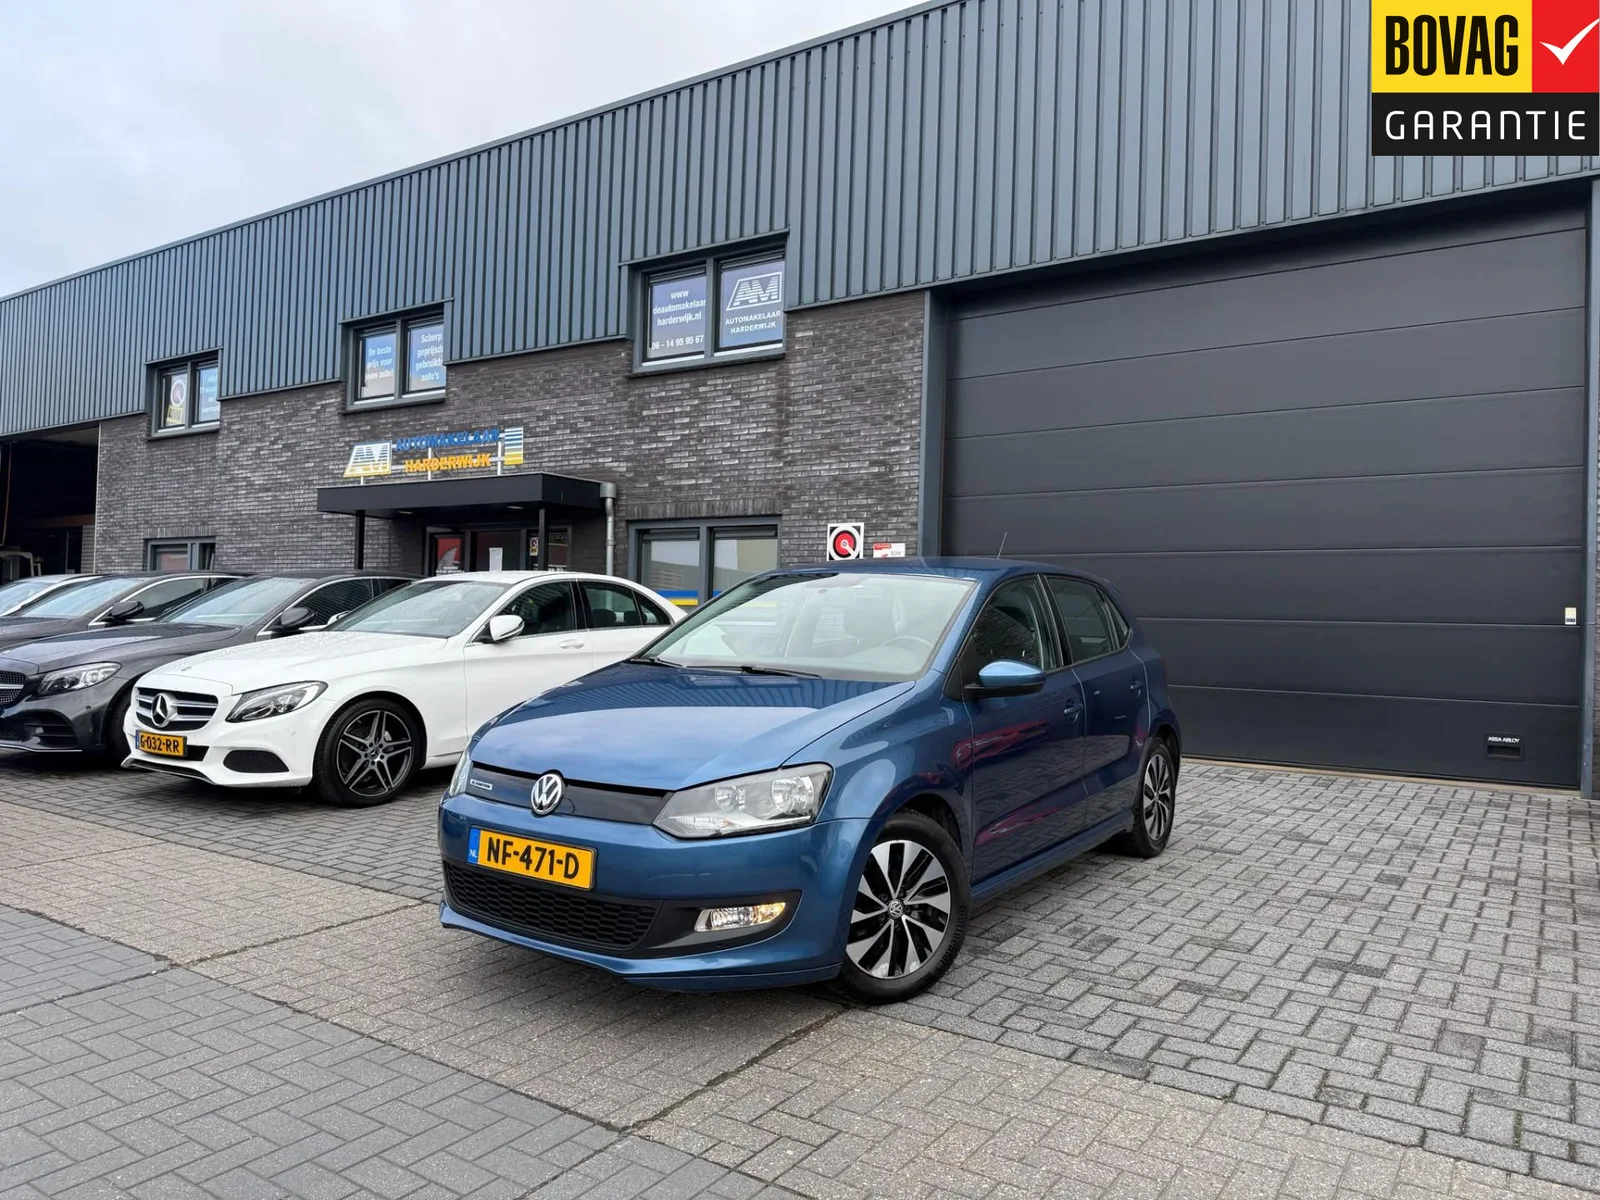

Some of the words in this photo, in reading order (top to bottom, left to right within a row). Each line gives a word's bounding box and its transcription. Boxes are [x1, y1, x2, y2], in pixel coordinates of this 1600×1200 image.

[657, 311, 702, 326] harderwijk.nl
[725, 310, 781, 325] AUTOMAKELAAR
[730, 321, 777, 334] HARDERWIJK
[420, 332, 443, 344] Scherp
[651, 340, 660, 350] 06
[666, 339, 674, 348] 14
[675, 337, 684, 347] 95
[685, 336, 694, 345] 95
[695, 334, 704, 344] 67
[395, 429, 501, 451] AUTOMAKELAAR
[404, 453, 492, 473] HARDERWIJK
[140, 734, 180, 753] G-032-RR
[469, 849, 478, 858] NL
[486, 837, 580, 880] NF-471-D
